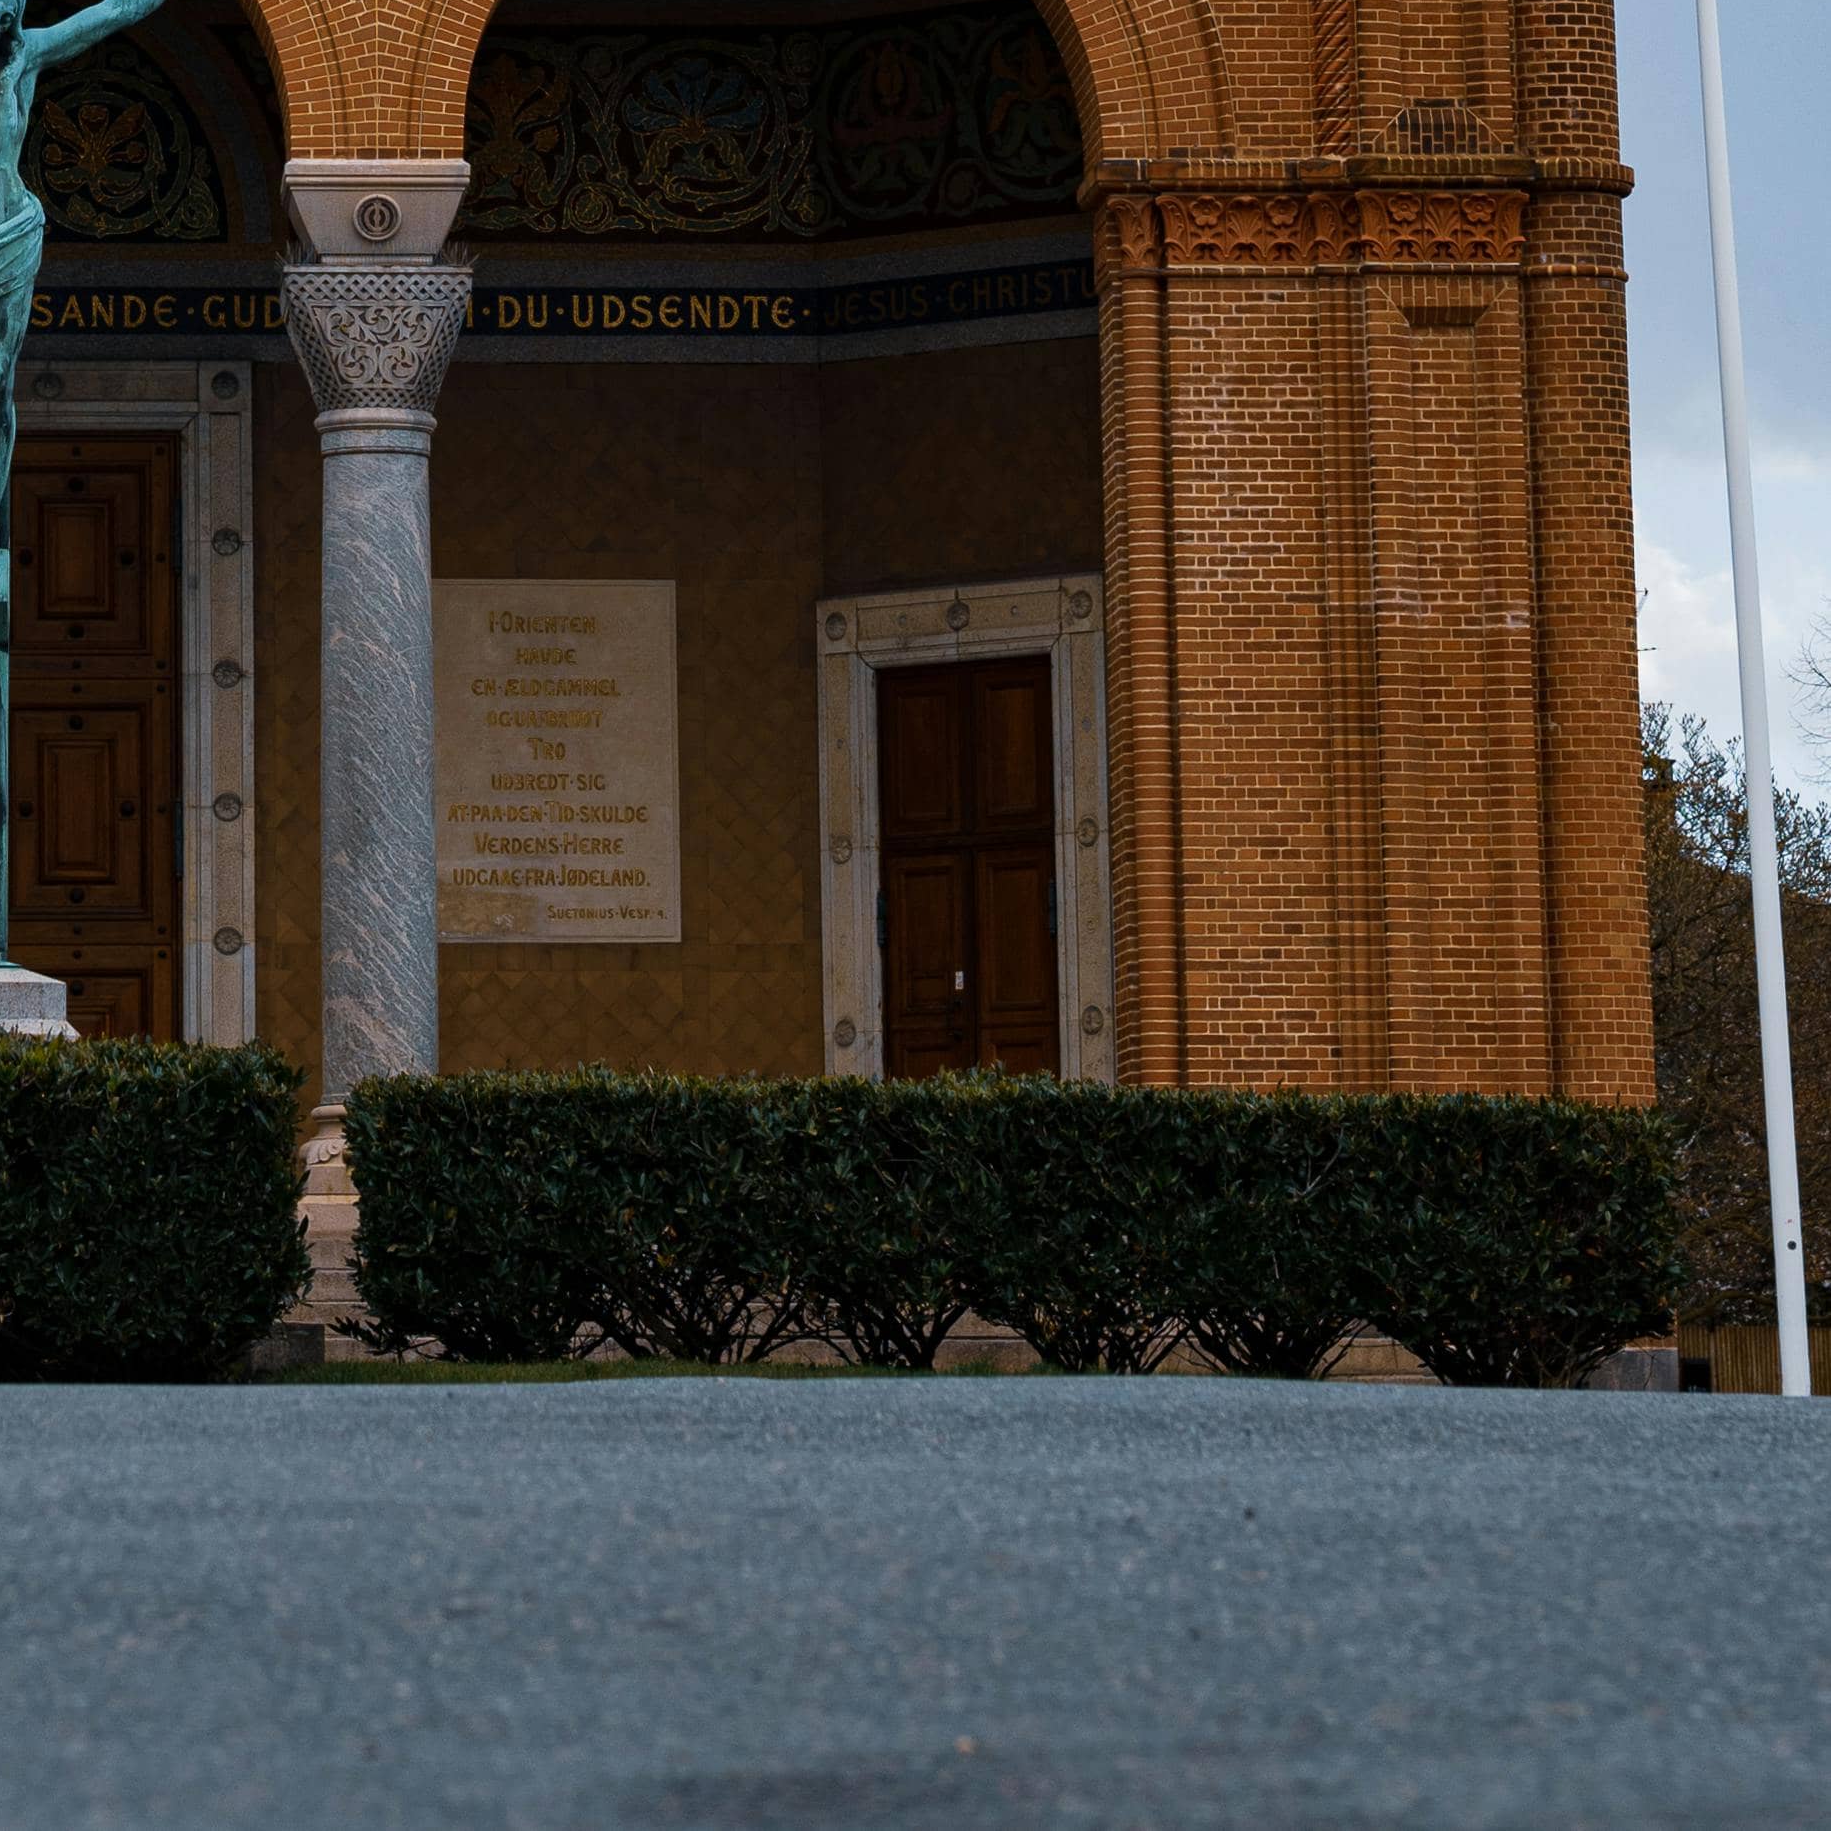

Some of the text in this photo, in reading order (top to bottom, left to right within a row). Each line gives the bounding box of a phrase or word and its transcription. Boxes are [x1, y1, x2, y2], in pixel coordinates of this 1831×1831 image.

[31, 293, 178, 329] SANDE
[497, 293, 548, 330] DU
[572, 294, 796, 330] UDSENDTE
[826, 283, 930, 328] JESUS
[500, 611, 596, 633] ORIENTEN
[471, 679, 496, 696] EN
[527, 737, 566, 760] TRO
[491, 773, 606, 791] UDBREDT SIG
[448, 804, 468, 823] AT
[471, 805, 503, 823] PAA
[507, 805, 542, 823] DEN
[579, 805, 648, 823] SKULDE
[473, 832, 624, 855] VERDENS HERRE
[525, 868, 556, 886] FRA
